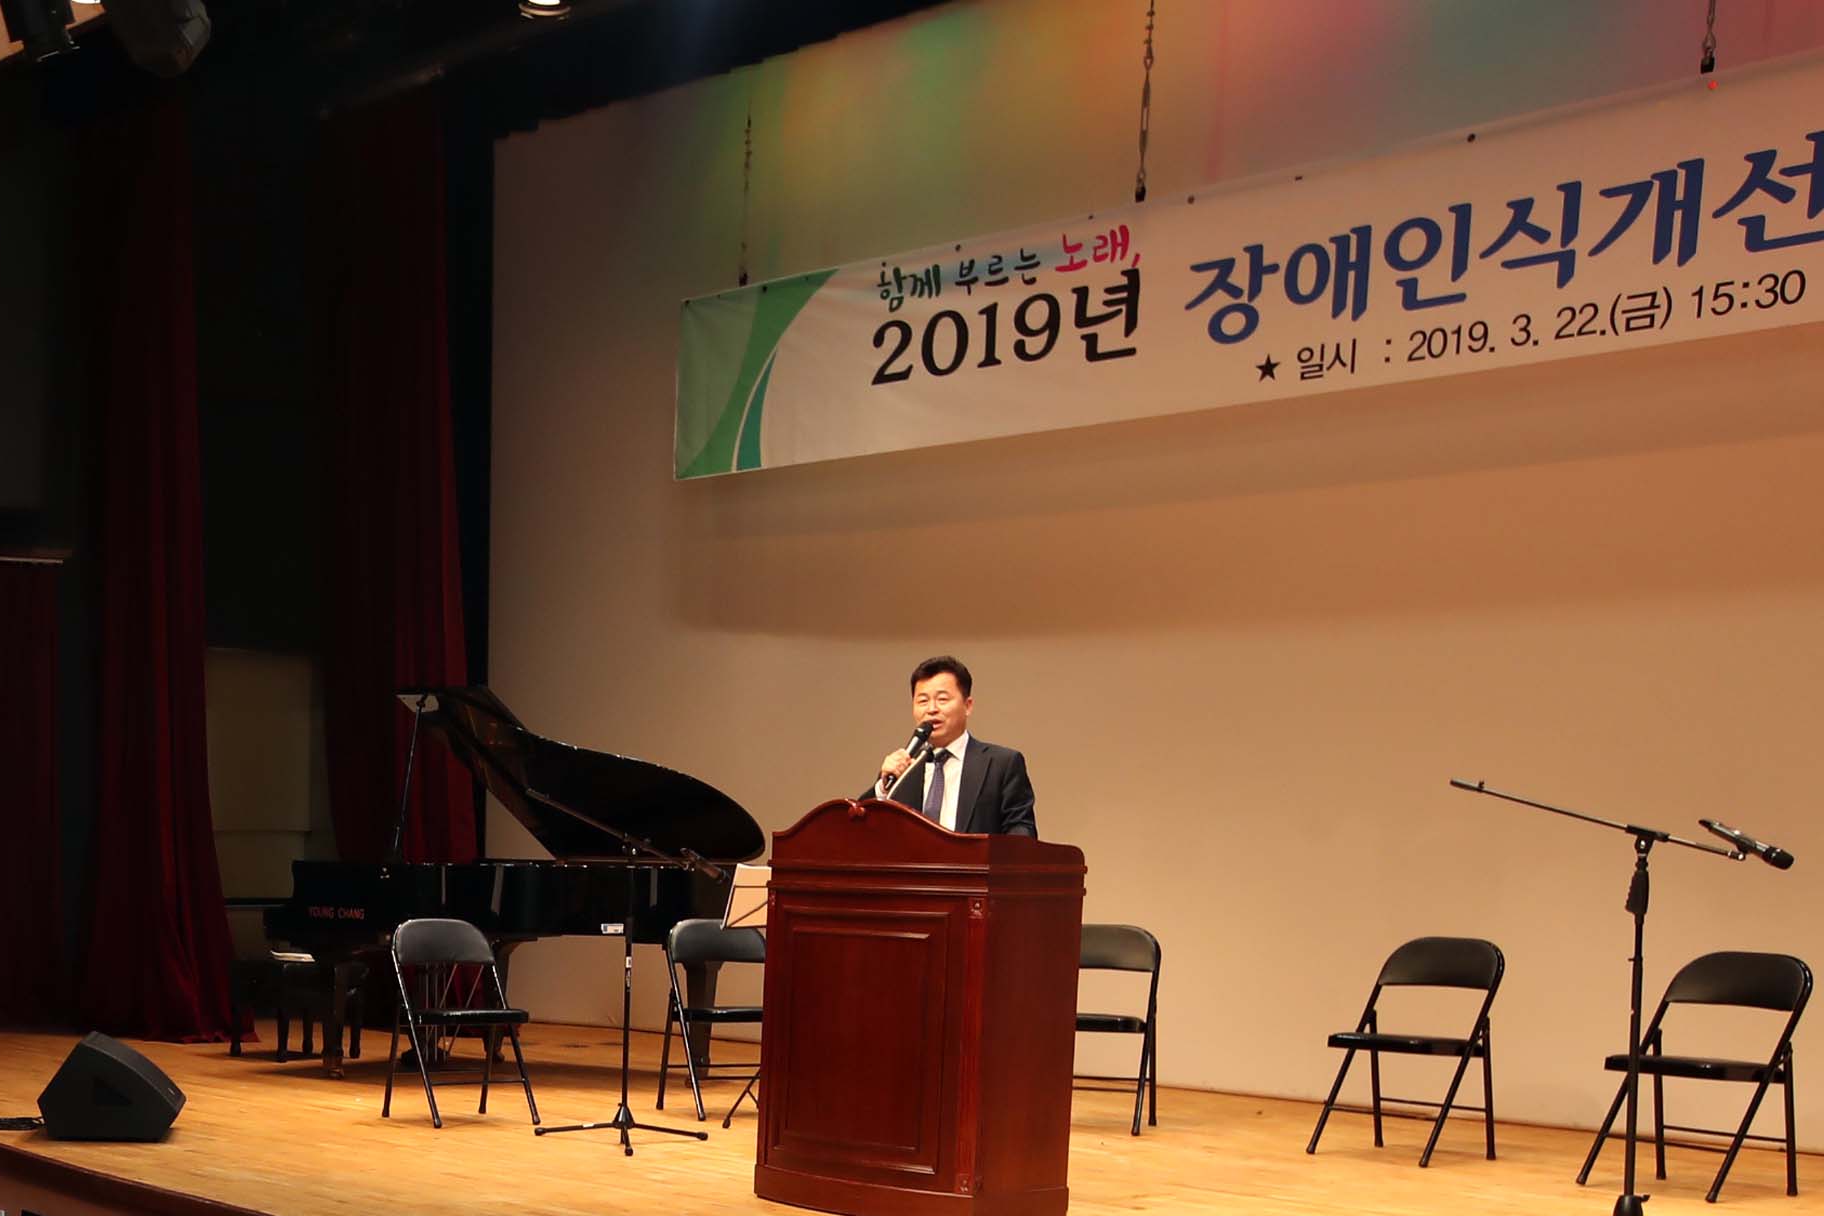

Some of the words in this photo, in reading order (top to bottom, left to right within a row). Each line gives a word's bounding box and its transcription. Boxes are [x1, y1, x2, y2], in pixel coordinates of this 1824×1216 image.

[871, 268, 1141, 386] 2019년
[1184, 130, 1824, 345] 장애인식개선
[876, 262, 941, 313] 함께
[954, 248, 1041, 296] 부르는
[1055, 224, 1141, 273] 노래,
[1294, 338, 1358, 381] 일시
[1406, 320, 1497, 362] 2019.
[1509, 313, 1541, 347] 3.
[1554, 286, 1674, 338] 22.(금)
[1690, 269, 1807, 319] 15:30
